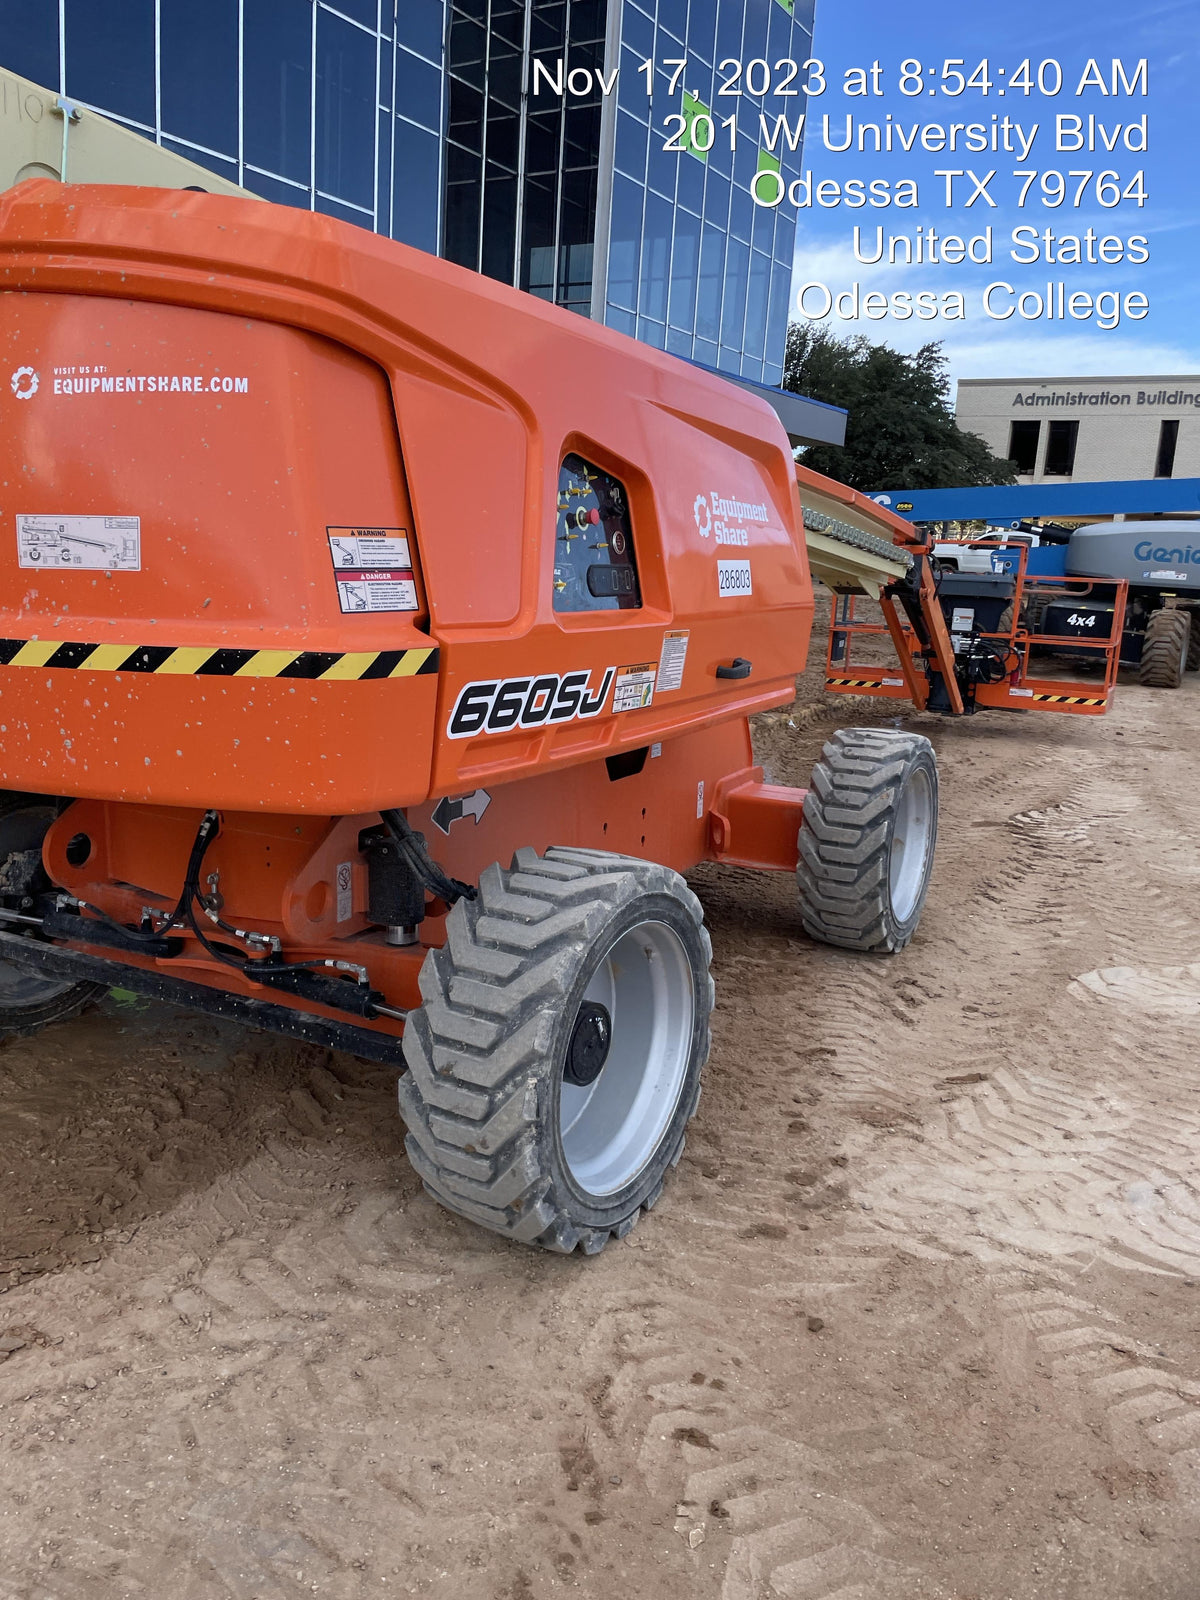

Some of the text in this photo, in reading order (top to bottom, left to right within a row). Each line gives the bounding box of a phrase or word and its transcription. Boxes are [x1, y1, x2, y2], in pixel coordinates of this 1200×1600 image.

[53, 365, 108, 375] VISIT US AT:
[53, 375, 249, 395] EQUIPMENTSHARE.COM
[1012, 390, 1200, 408] Administration Building
[710, 491, 769, 523] Equipment
[356, 529, 387, 537] WARNING
[713, 520, 749, 546] Share
[719, 569, 751, 590] 286803
[1066, 613, 1097, 628] 4x4
[447, 667, 615, 738] 660SJ
